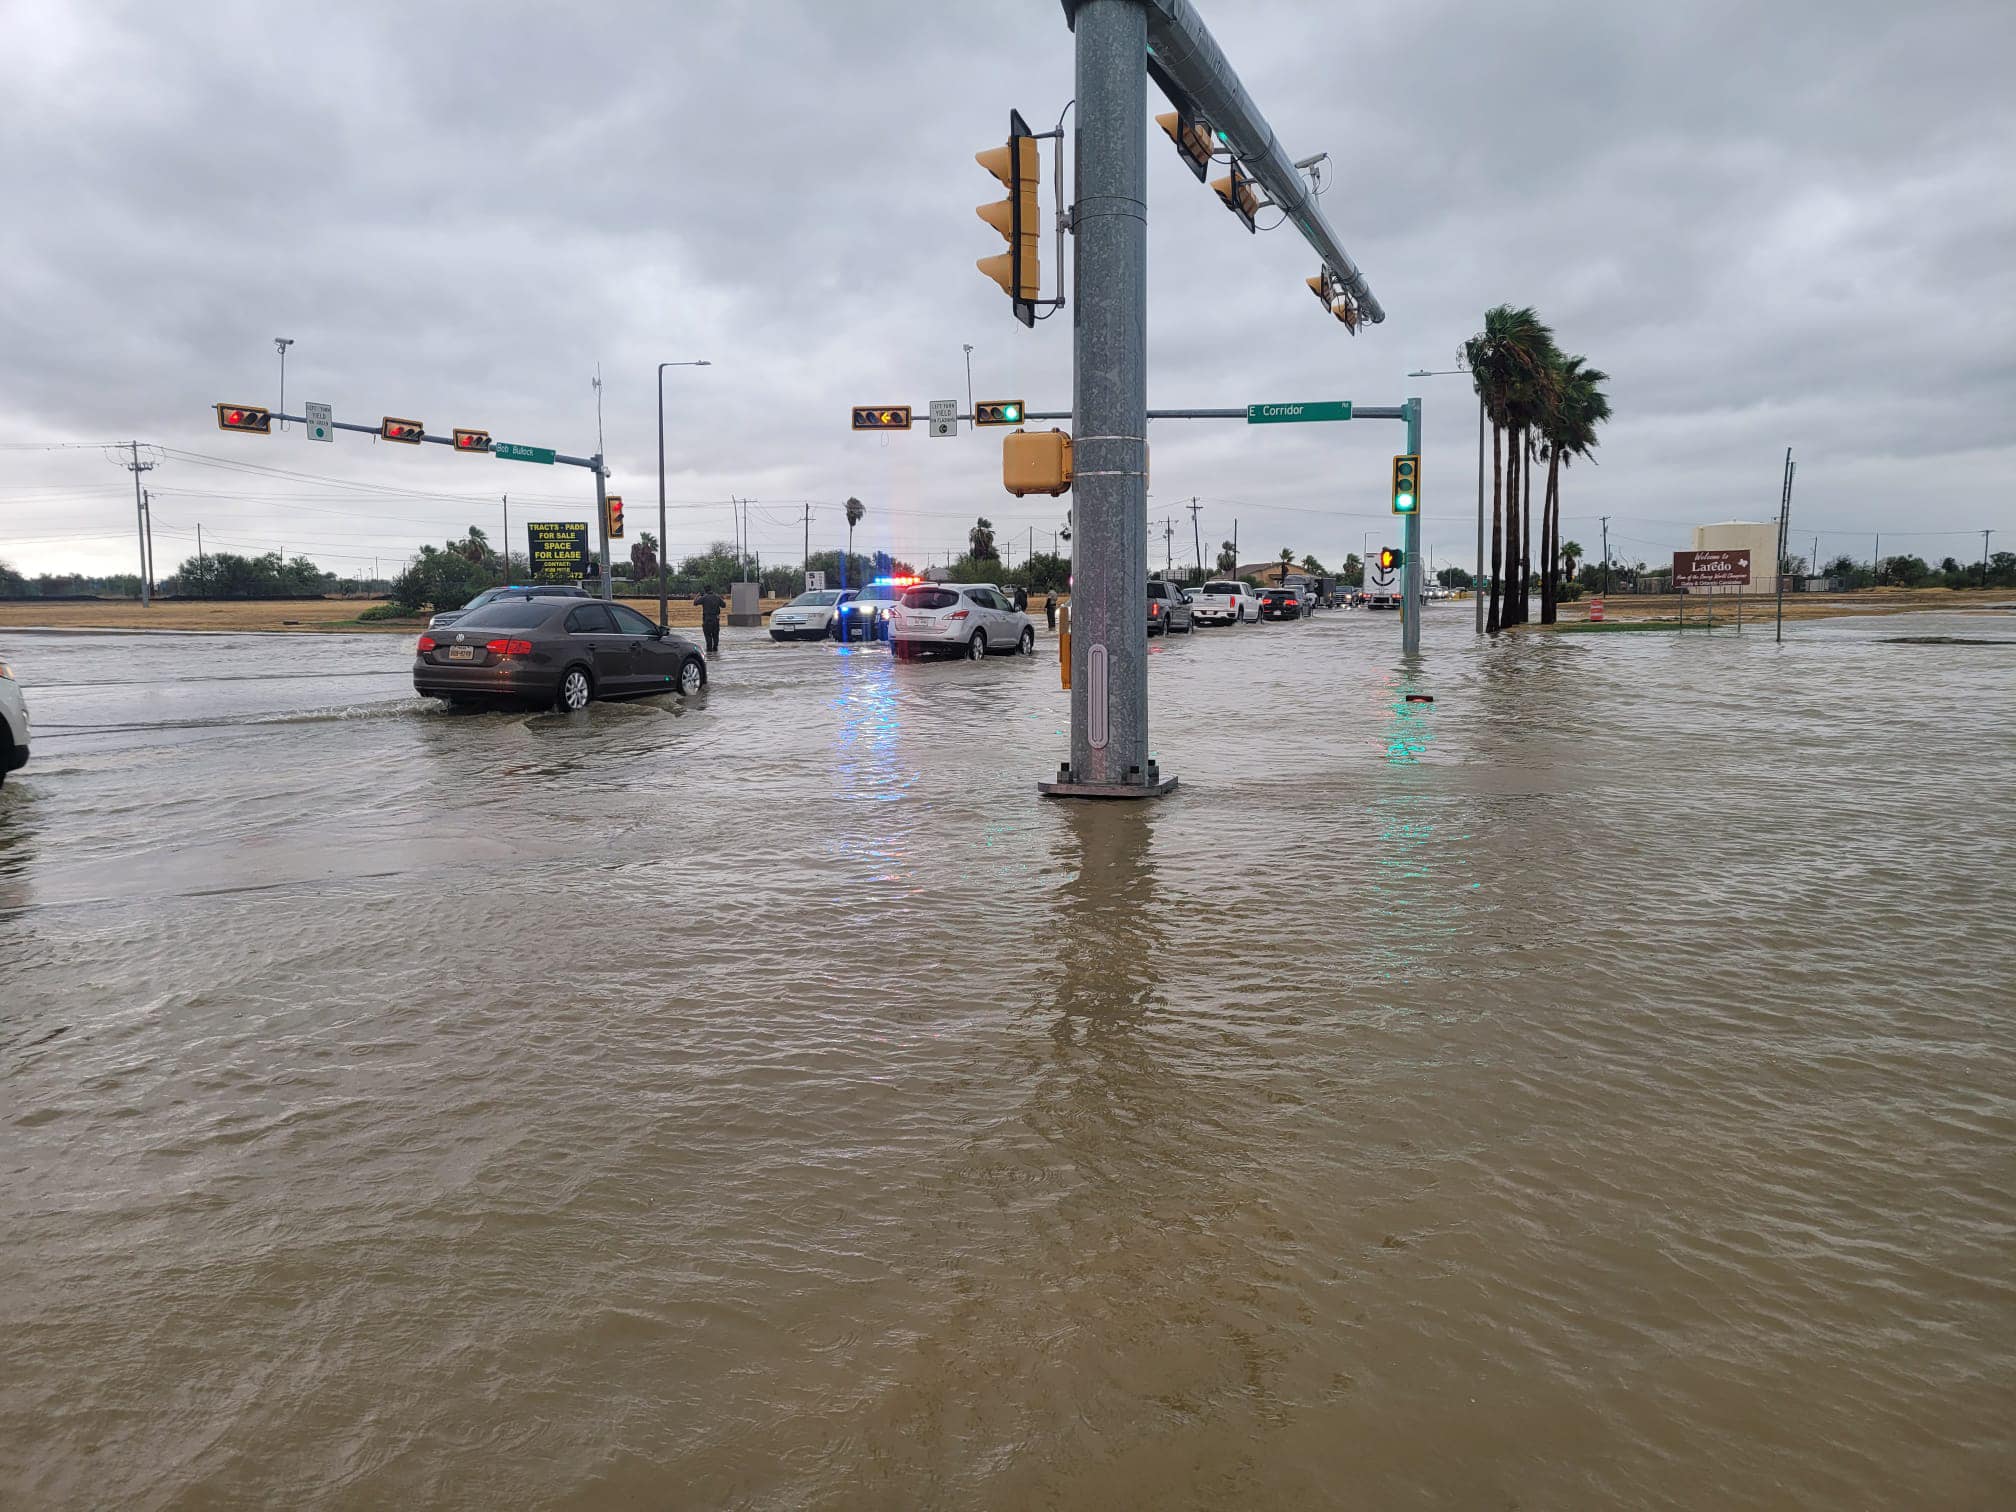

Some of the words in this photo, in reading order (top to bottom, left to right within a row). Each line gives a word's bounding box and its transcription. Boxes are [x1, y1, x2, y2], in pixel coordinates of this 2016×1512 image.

[1249, 406, 1256, 416] E
[1263, 405, 1304, 416] Corridor
[1692, 561, 1732, 572] Laredo
